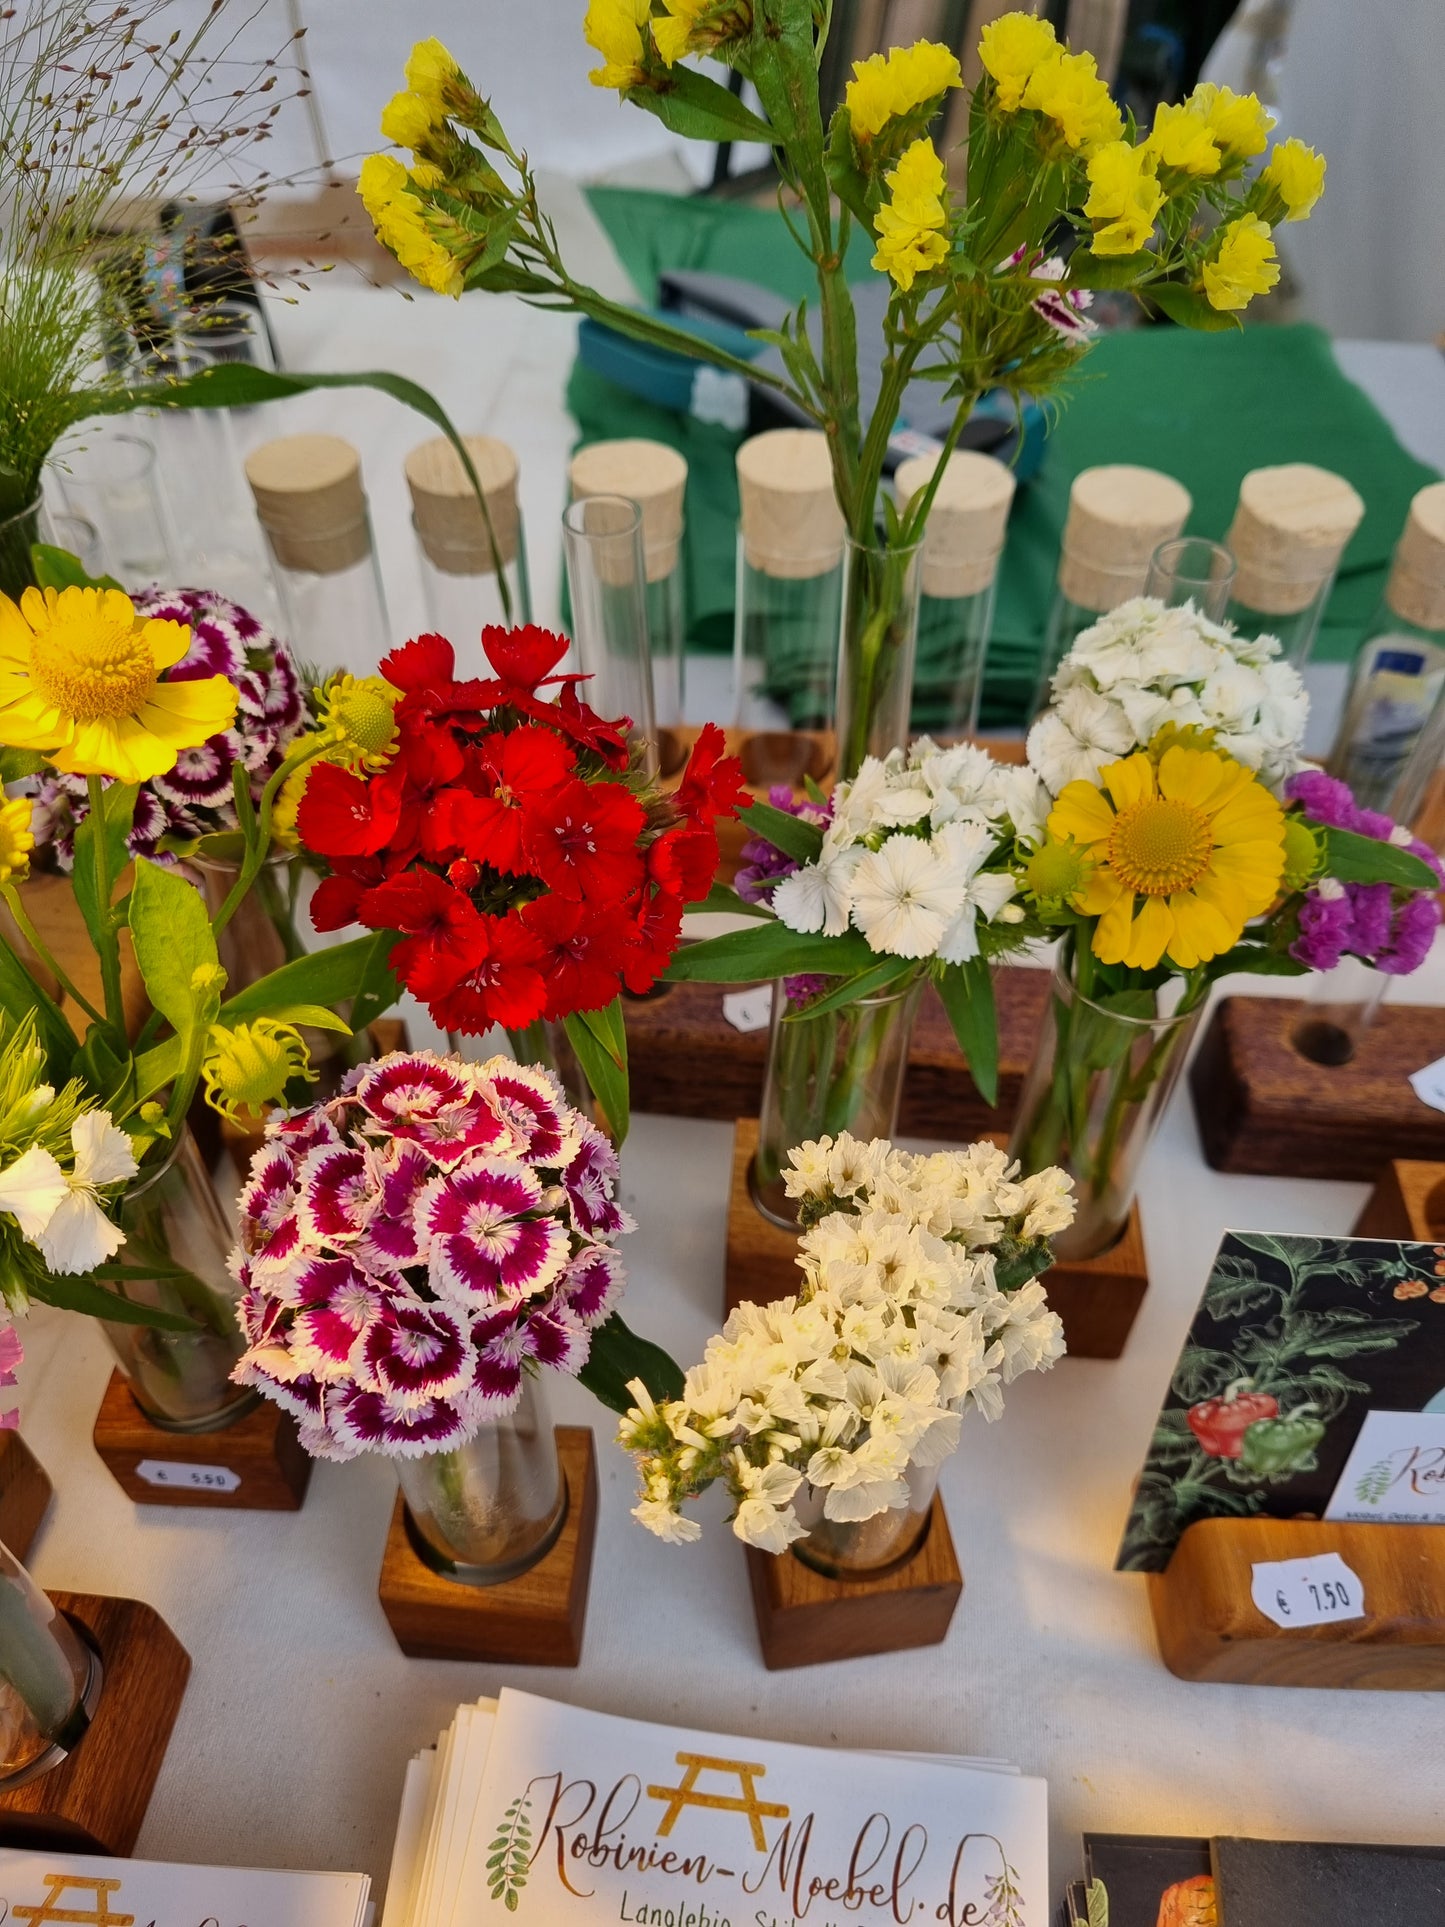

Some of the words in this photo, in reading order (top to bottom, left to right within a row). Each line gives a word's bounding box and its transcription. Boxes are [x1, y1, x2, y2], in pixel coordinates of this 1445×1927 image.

[1276, 1589, 1291, 1615] €
[1308, 1581, 1350, 1611] 7.50
[528, 1771, 1002, 1927] Robinien-Moebel.de
